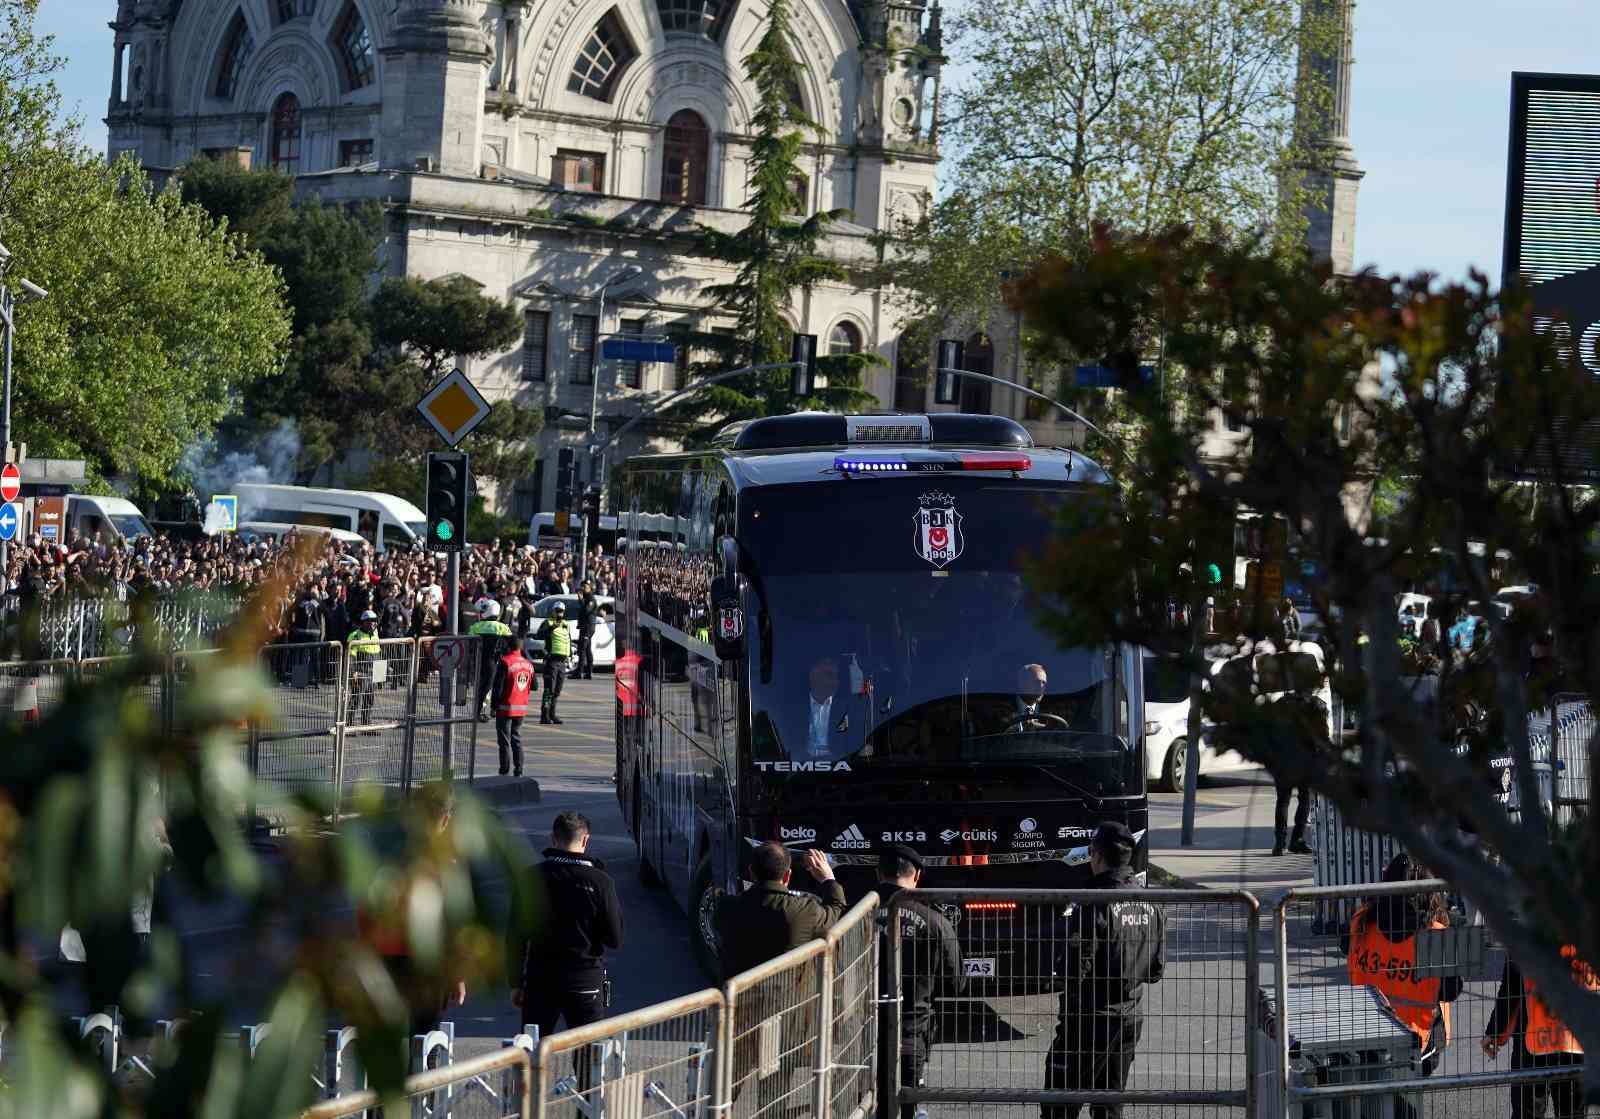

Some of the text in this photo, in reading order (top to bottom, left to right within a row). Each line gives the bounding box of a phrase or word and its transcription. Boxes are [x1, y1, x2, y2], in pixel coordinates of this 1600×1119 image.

[922, 463, 945, 471] SHN
[926, 550, 955, 560] 1903
[754, 760, 852, 772] TEMSA
[780, 826, 817, 839] beko
[961, 829, 998, 842] GÜRİŞ
[1014, 832, 1043, 840] SOMPO
[831, 839, 871, 849] adidas
